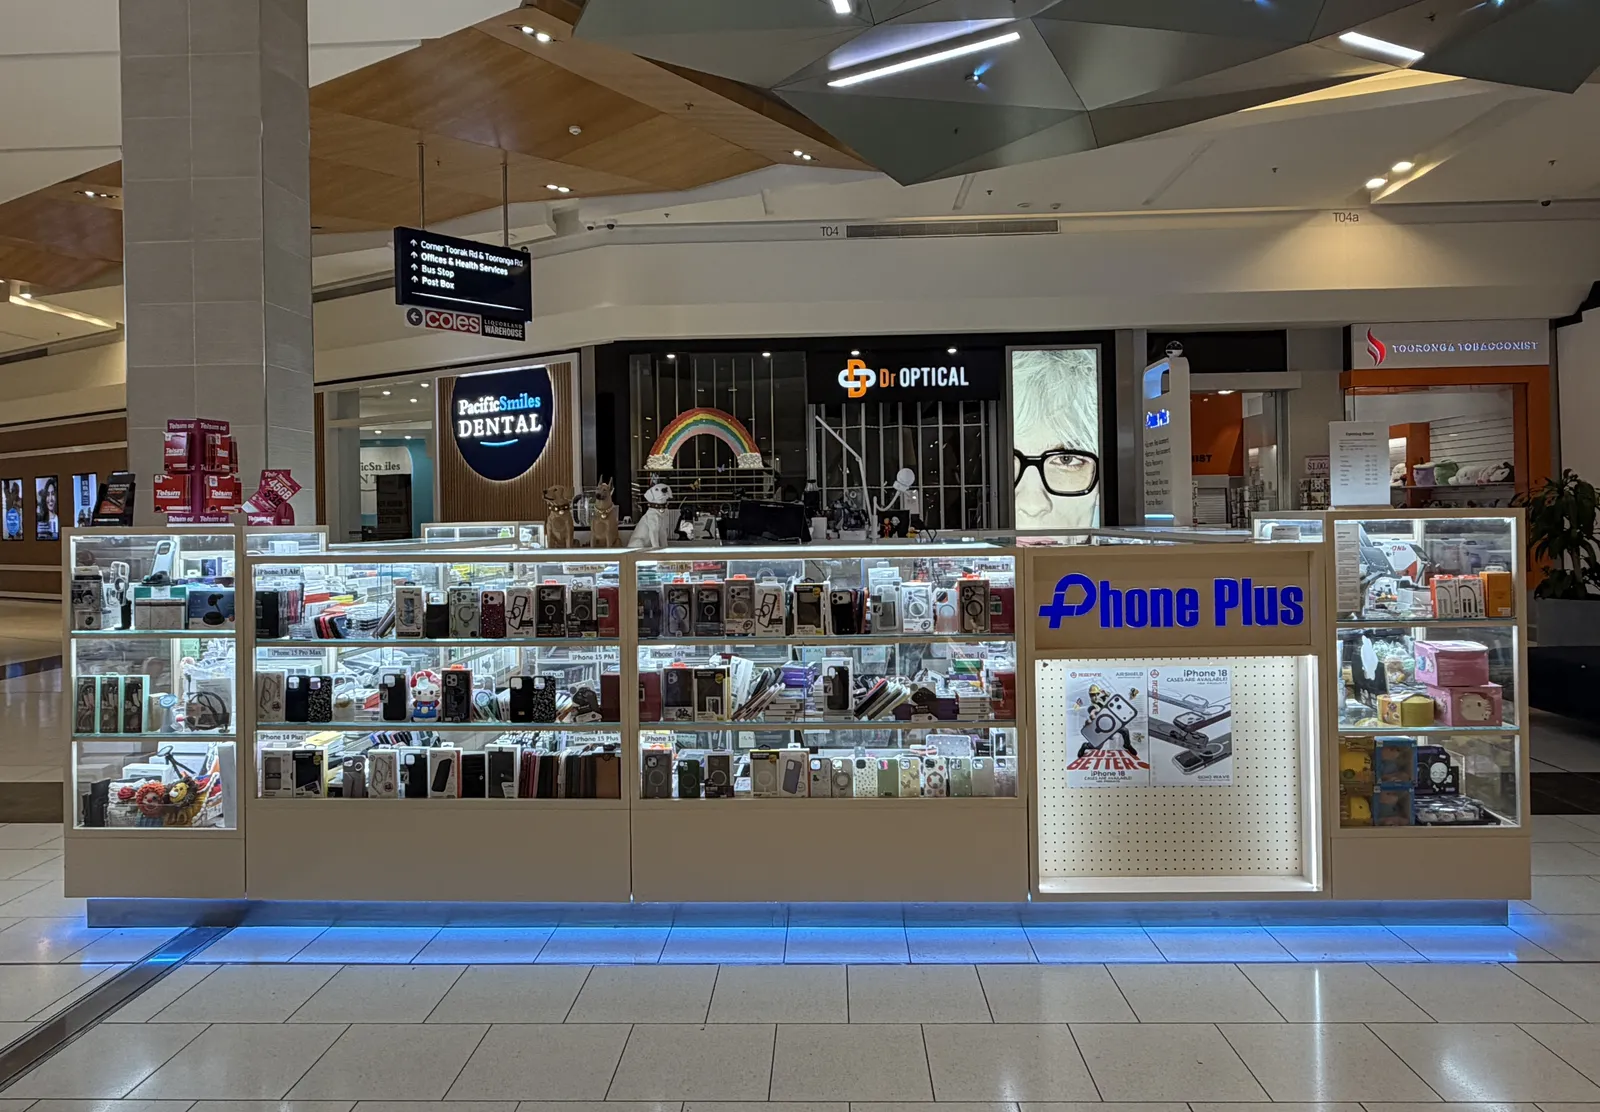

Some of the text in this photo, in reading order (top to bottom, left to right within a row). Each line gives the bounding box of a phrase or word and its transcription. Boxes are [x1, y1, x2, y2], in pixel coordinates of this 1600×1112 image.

[1332, 212, 1360, 223] T04a
[420, 240, 524, 268] Corner Toorak Rd & Tooronga Rd
[421, 252, 508, 276] Offices & Health Services
[421, 264, 455, 279] Bus Stop
[421, 276, 455, 289] Post Box
[426, 311, 480, 333] coles
[484, 325, 523, 338] WAREHOUSE
[1392, 342, 1538, 353] TOORONGA TOBACCONIST
[879, 366, 969, 388] Dr OPTICAL
[458, 414, 542, 438] DENTAL
[1038, 572, 1304, 628] Phone Plus
